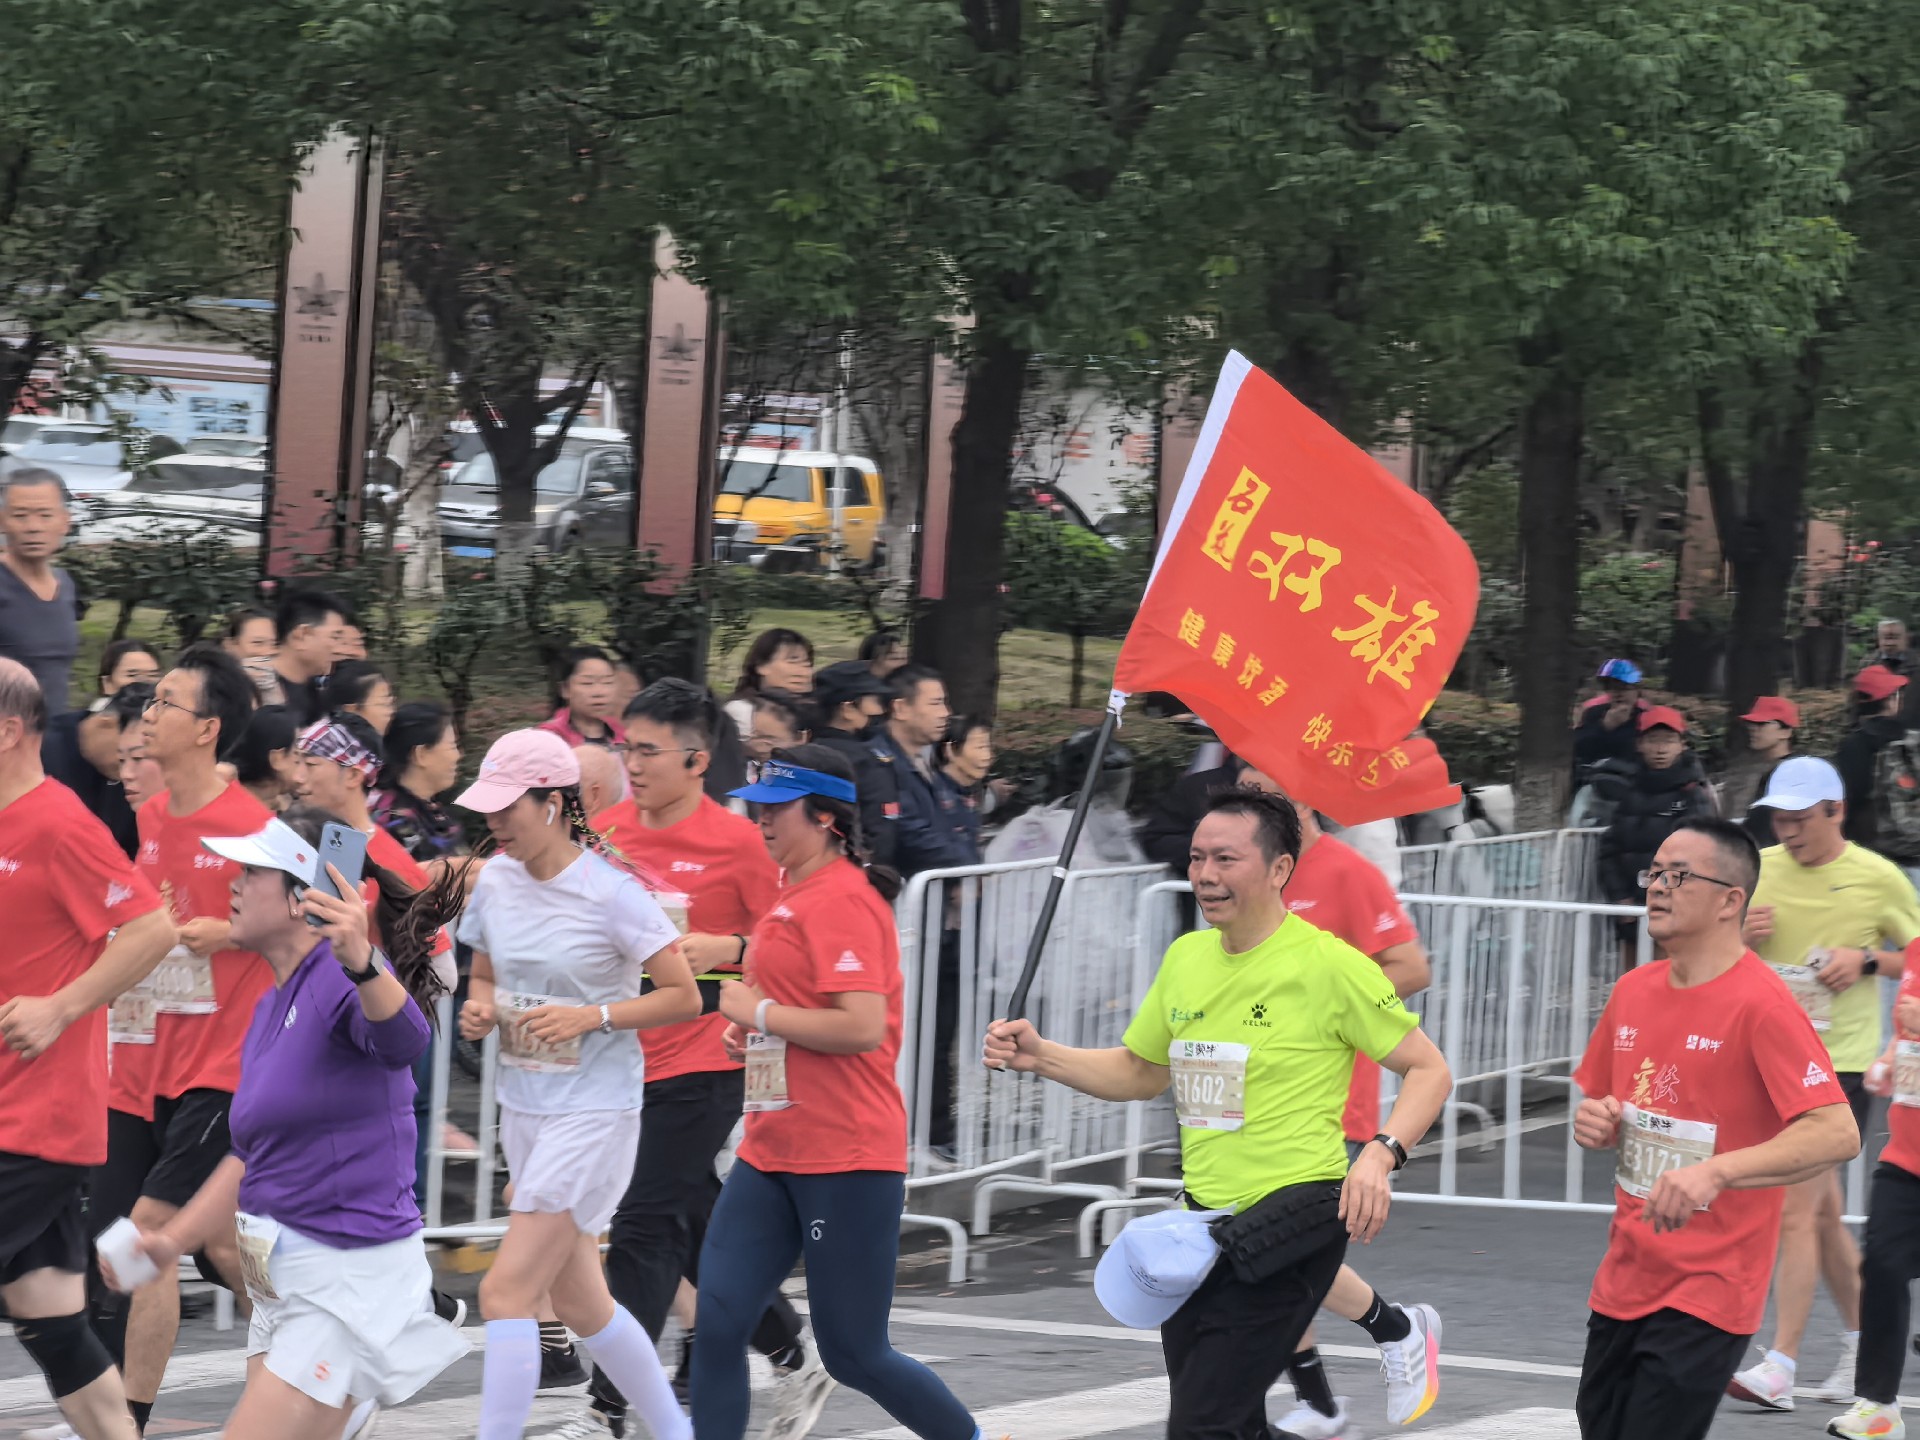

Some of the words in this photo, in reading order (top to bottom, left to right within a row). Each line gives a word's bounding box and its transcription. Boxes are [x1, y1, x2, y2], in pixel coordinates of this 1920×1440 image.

[1247, 531, 1440, 690] 双雄
[1177, 607, 1289, 706] 健康饮酒
[1242, 1019, 1272, 1028] KELME
[1174, 1073, 1225, 1105] E1602
